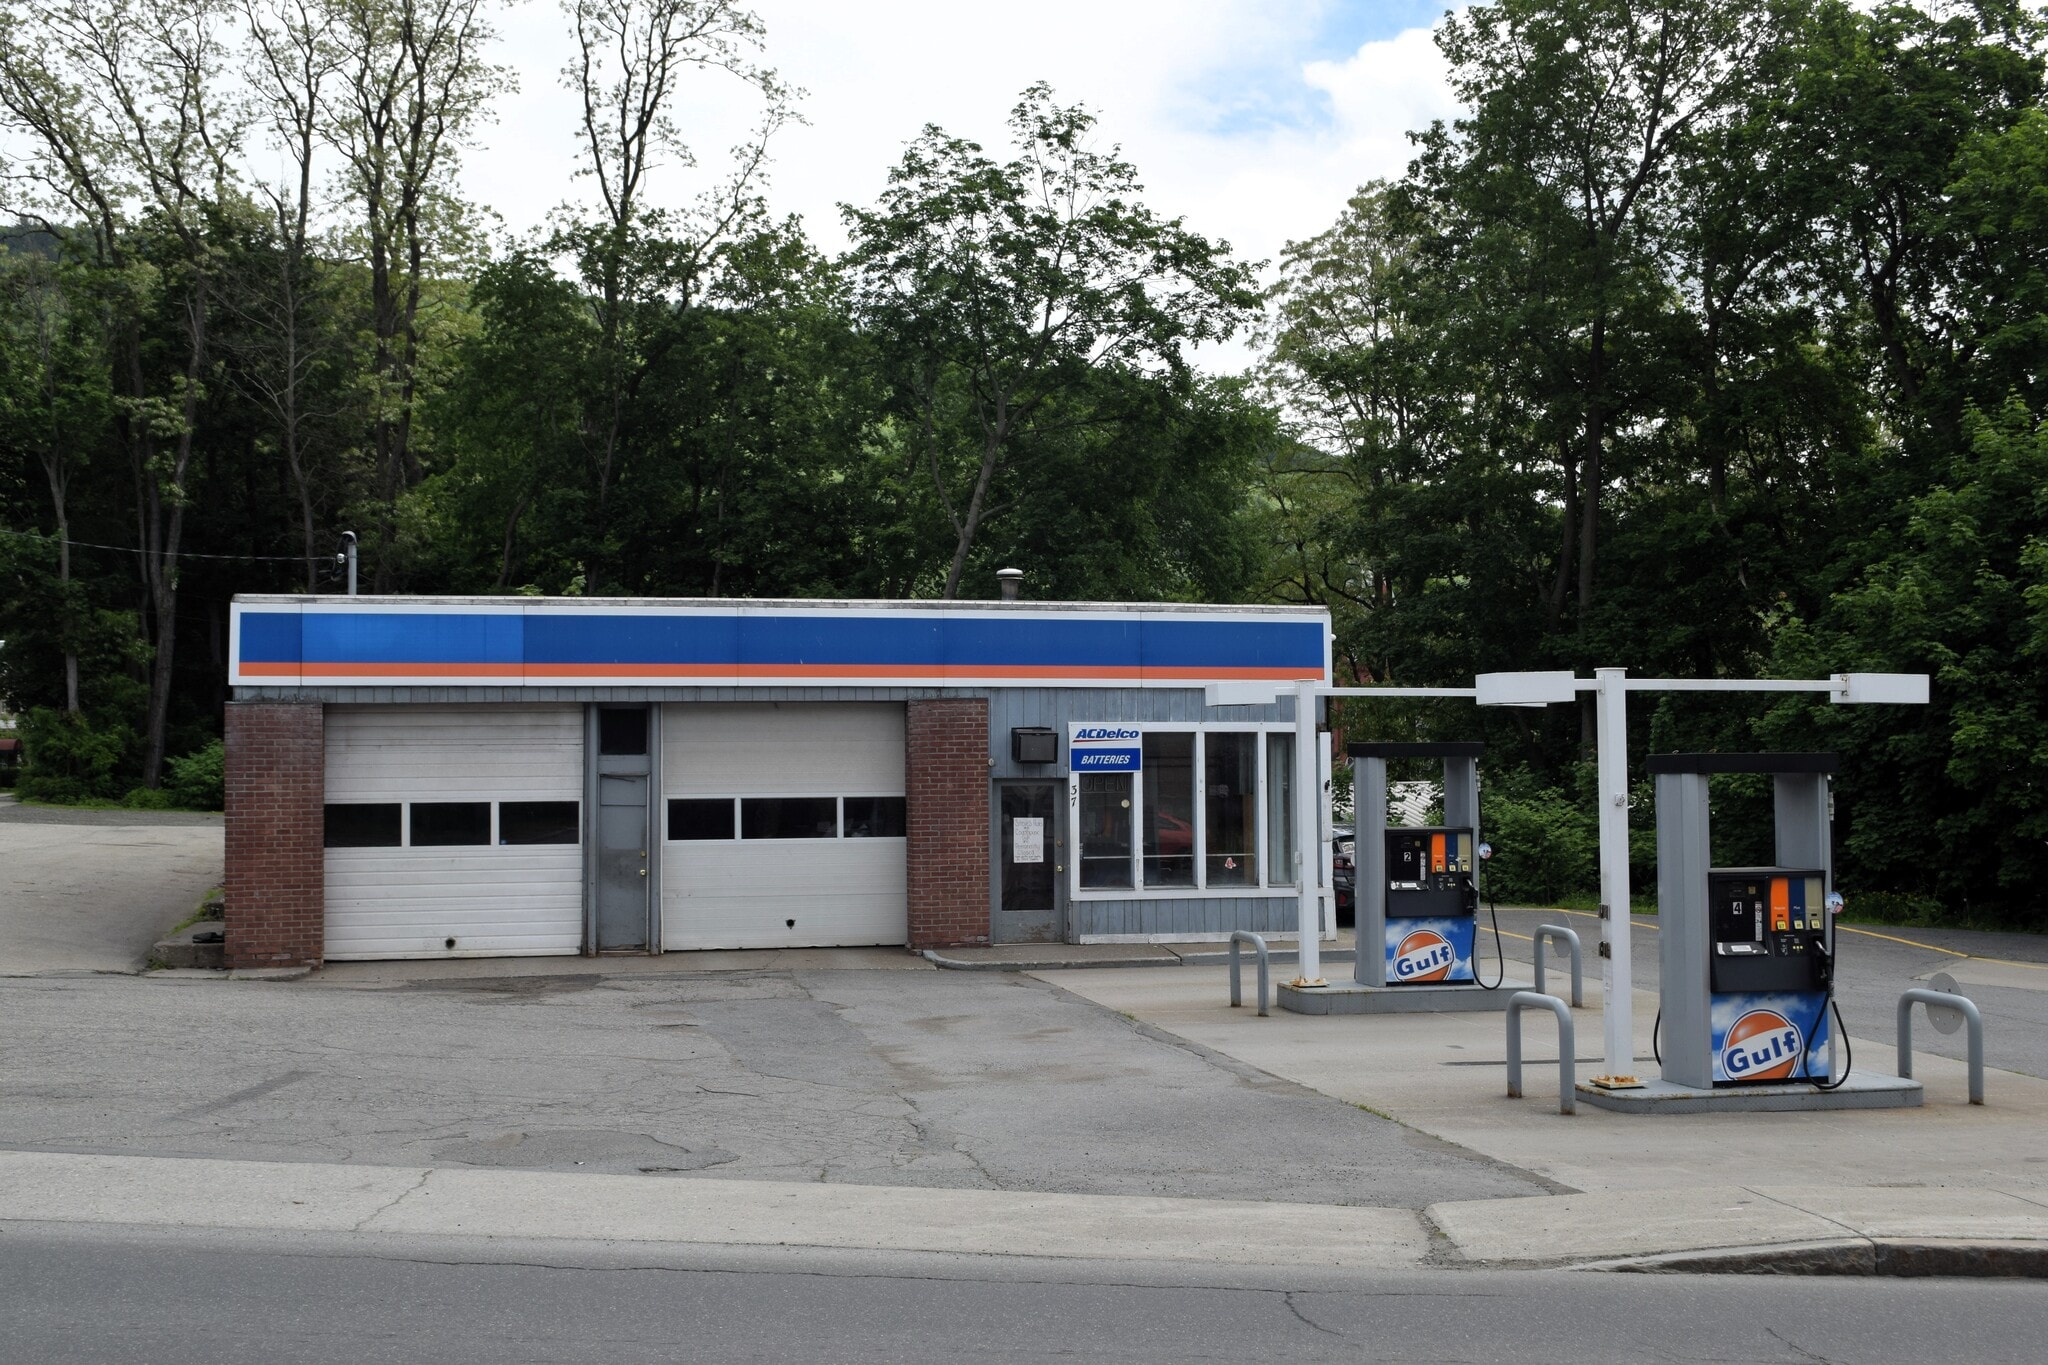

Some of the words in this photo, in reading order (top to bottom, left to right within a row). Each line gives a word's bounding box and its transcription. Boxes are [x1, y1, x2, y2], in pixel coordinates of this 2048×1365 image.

[1075, 728, 1140, 739] ACDelco
[1081, 755, 1131, 764] BATTERIES
[1081, 775, 1127, 792] OPEN
[1404, 852, 1411, 861] 2
[1734, 902, 1741, 914] 4
[1396, 946, 1450, 976] Gulf
[1727, 1031, 1796, 1073] Gulf
